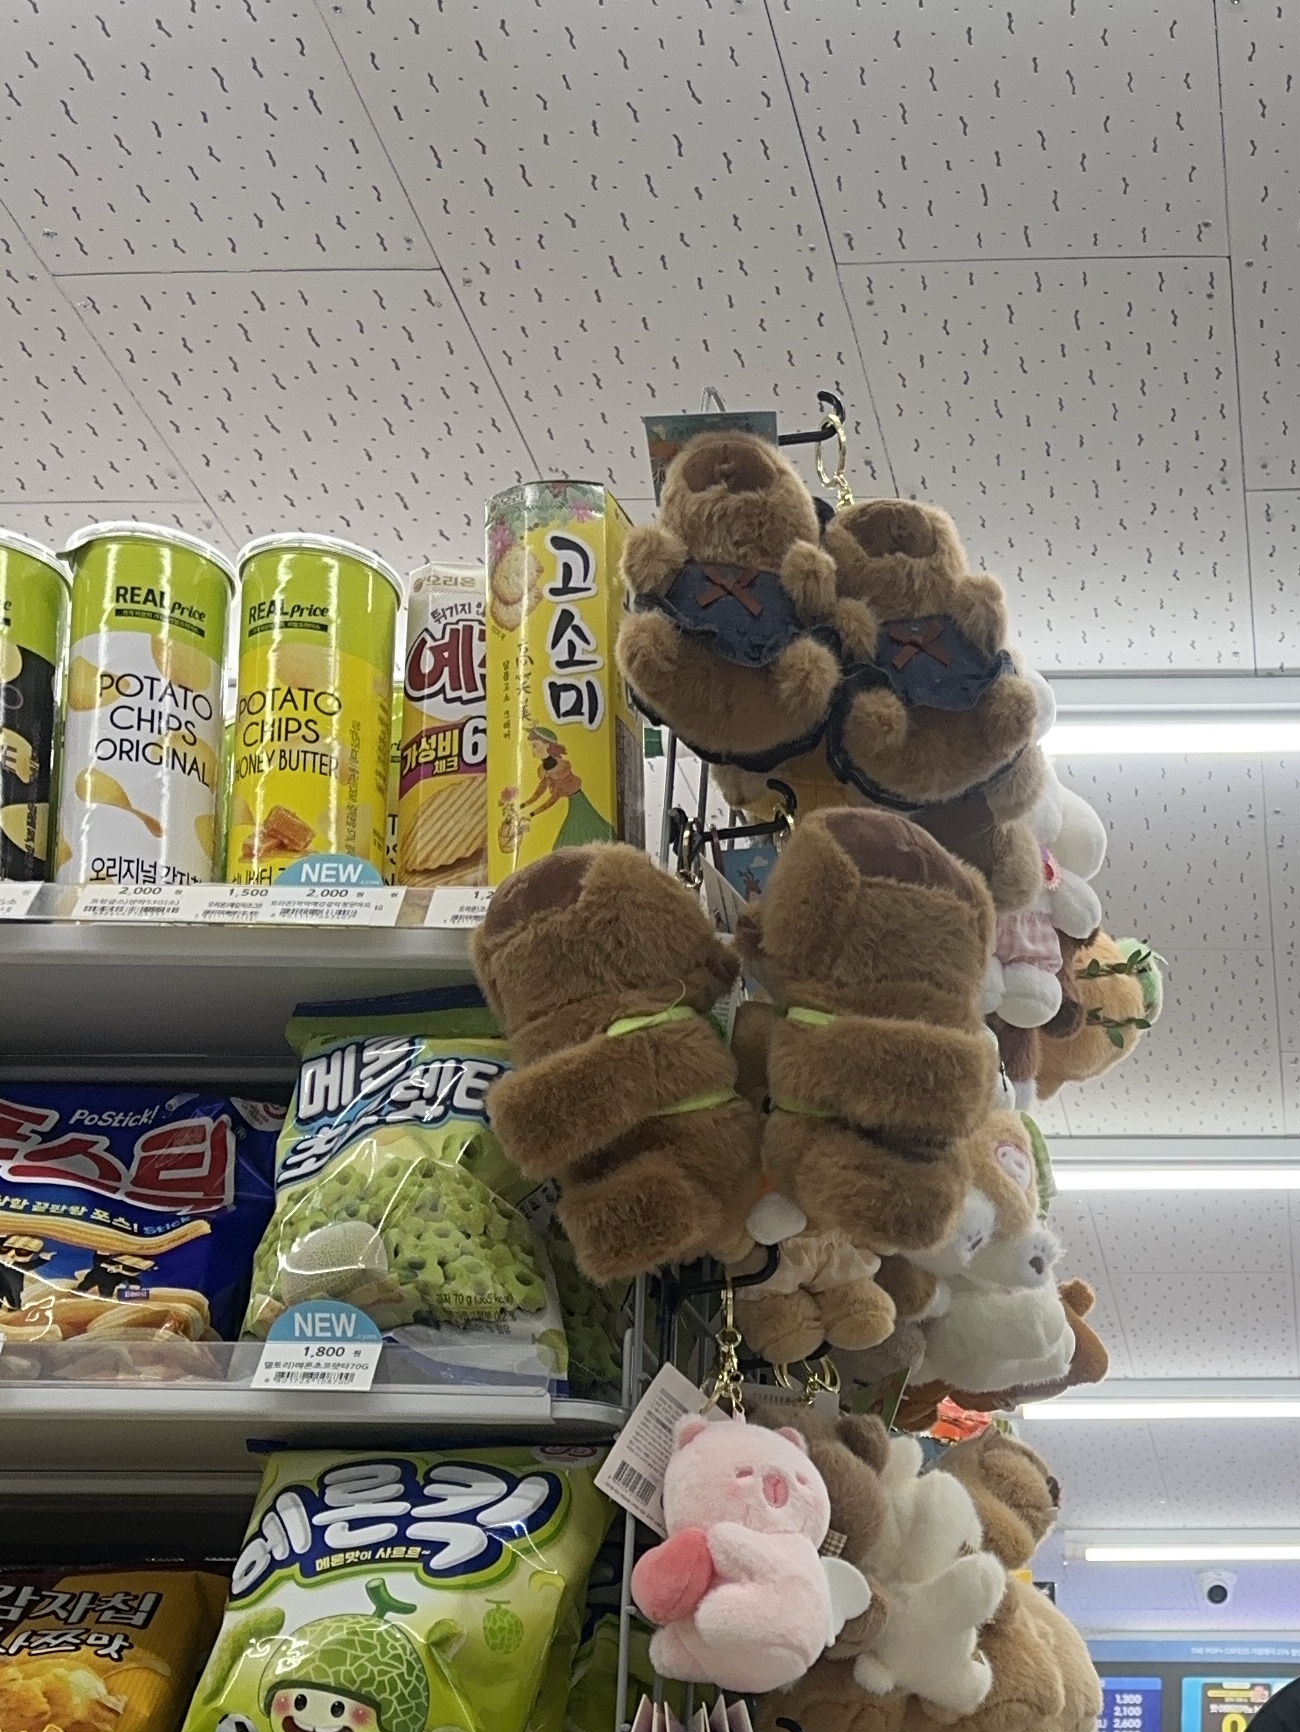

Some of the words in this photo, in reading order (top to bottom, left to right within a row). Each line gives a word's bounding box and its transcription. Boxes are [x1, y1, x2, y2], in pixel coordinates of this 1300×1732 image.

[426, 574, 477, 588] 오리온
[115, 585, 169, 609] REAL
[170, 601, 207, 623] Price
[248, 598, 289, 625] REAL
[289, 603, 329, 619] Price
[430, 601, 472, 624] 튀기지
[548, 533, 602, 728] 고소미
[407, 622, 486, 697] 예
[99, 673, 213, 722] POTATO
[238, 686, 342, 724] POTATO
[109, 705, 197, 747] CHIPS
[242, 718, 320, 748] CHIPS
[94, 738, 210, 788] ORIGINAL
[402, 729, 460, 776] 가성비
[234, 749, 274, 784] HONEY
[278, 749, 339, 778] BUTTER
[432, 759, 460, 776] 체크
[89, 856, 158, 886] 오리지널
[300, 863, 363, 883] NEW
[118, 886, 162, 896] 2,000
[228, 888, 269, 898] 1,500
[305, 888, 349, 898] 2,000
[68, 1105, 160, 1128] PoStick!
[293, 1312, 357, 1338] NEW
[303, 1346, 346, 1359] 1,800
[314, 1549, 373, 1573] 메론맛이
